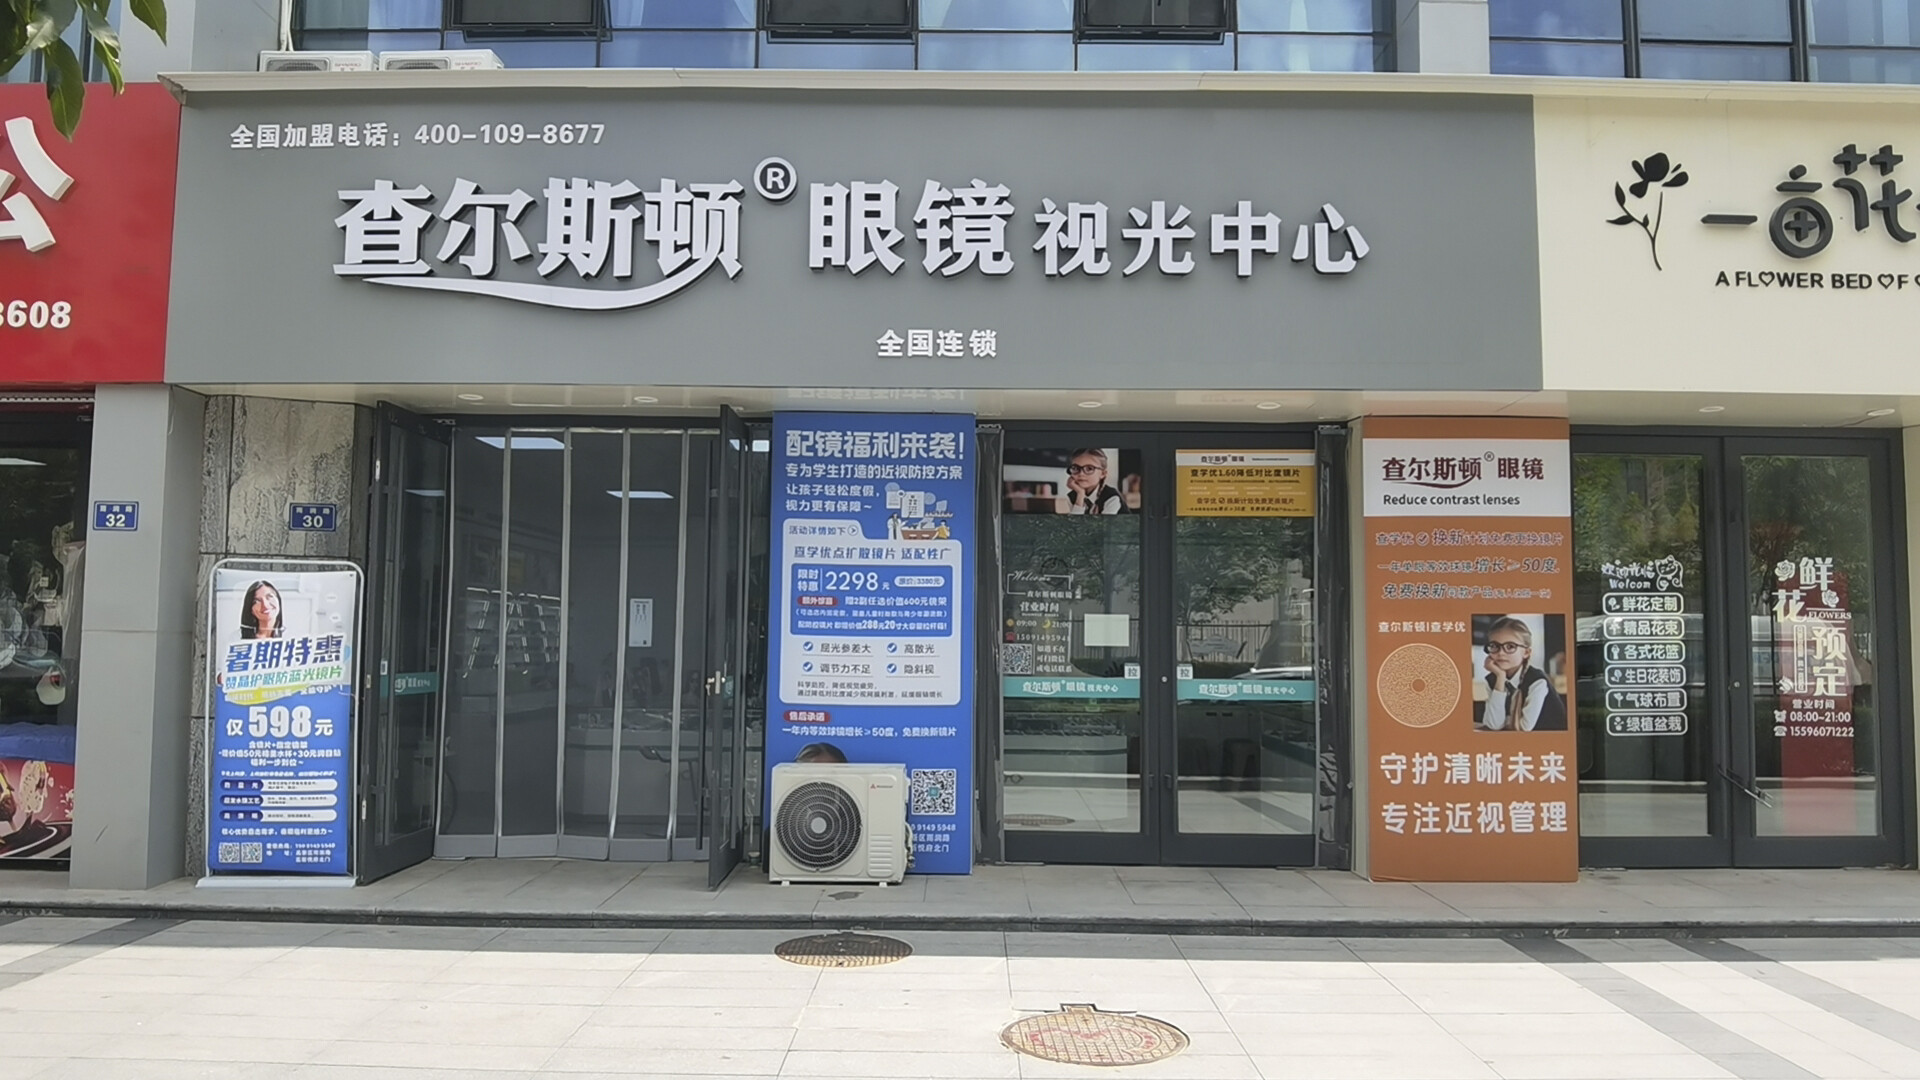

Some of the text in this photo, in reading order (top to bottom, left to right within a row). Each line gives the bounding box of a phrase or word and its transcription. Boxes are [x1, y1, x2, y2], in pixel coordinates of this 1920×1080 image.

[1715, 270, 1730, 287] A
[1831, 273, 1873, 289] BED
[0, 299, 72, 329] 608
[876, 329, 998, 358] 全国连锁
[785, 463, 963, 480] 专为学生打造的近视防控方案
[1383, 494, 1520, 505] Reduce contrast lenses
[106, 514, 125, 526] 32
[303, 515, 323, 527] 30
[789, 525, 846, 536] 活动详情如下
[901, 548, 951, 560] 适配性广
[825, 571, 890, 591] 2298 元
[1020, 602, 1059, 612] 营业时间
[1623, 597, 1677, 610] 鲜花定制
[1808, 611, 1851, 620] FLOWERS
[1624, 621, 1679, 635] 精品花束
[226, 635, 343, 673] 暑期特惠
[820, 643, 935, 654] 屈光参差大 高散光
[1625, 645, 1679, 659] 各式花篮
[820, 664, 935, 674] 调节力不足 隐斜视
[1625, 669, 1681, 683] 生日花装饰
[1626, 693, 1681, 708] 气球布置
[1793, 700, 1835, 709] 营业时间
[1627, 717, 1682, 732] 绿植盆栽
[1790, 726, 1854, 737] 15596071222
[1380, 752, 1566, 784] 守护清晰未来
[1382, 801, 1567, 834] 专注近视管理
